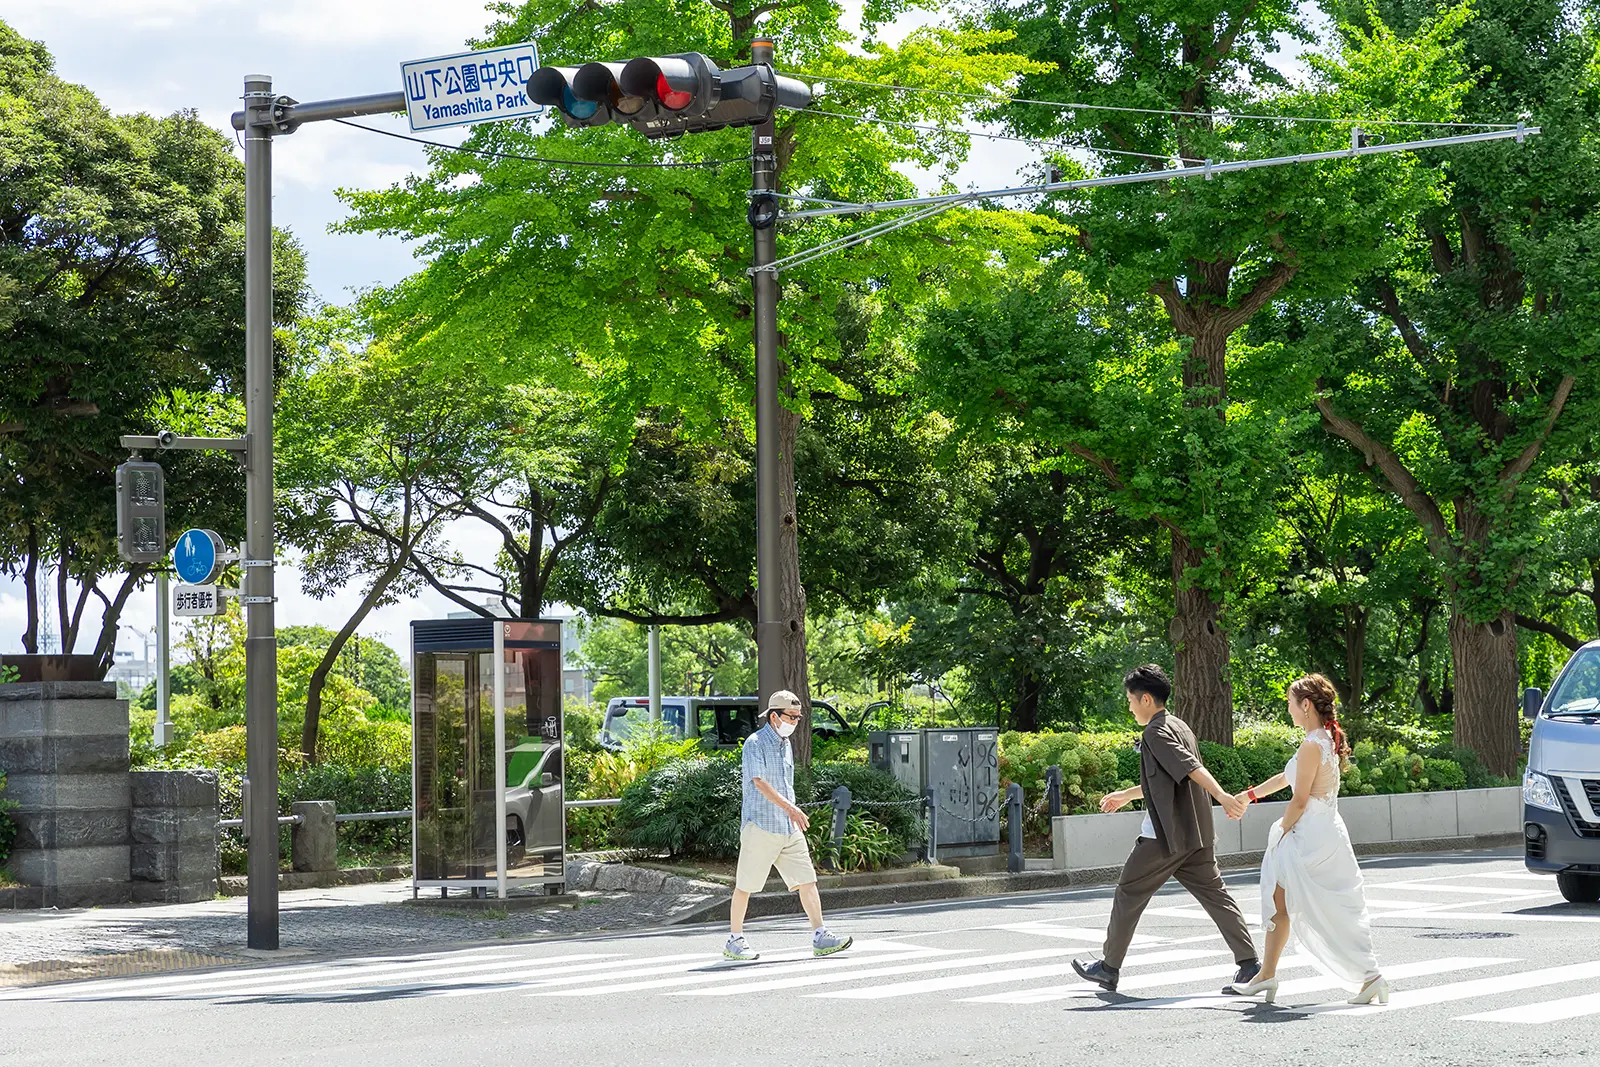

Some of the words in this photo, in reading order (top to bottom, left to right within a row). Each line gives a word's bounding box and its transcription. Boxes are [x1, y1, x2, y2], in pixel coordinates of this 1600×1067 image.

[407, 56, 534, 101] 山下公園中央口
[423, 97, 493, 120] Yamashita
[496, 91, 528, 109] Park
[176, 591, 213, 611] 歩行者優先
